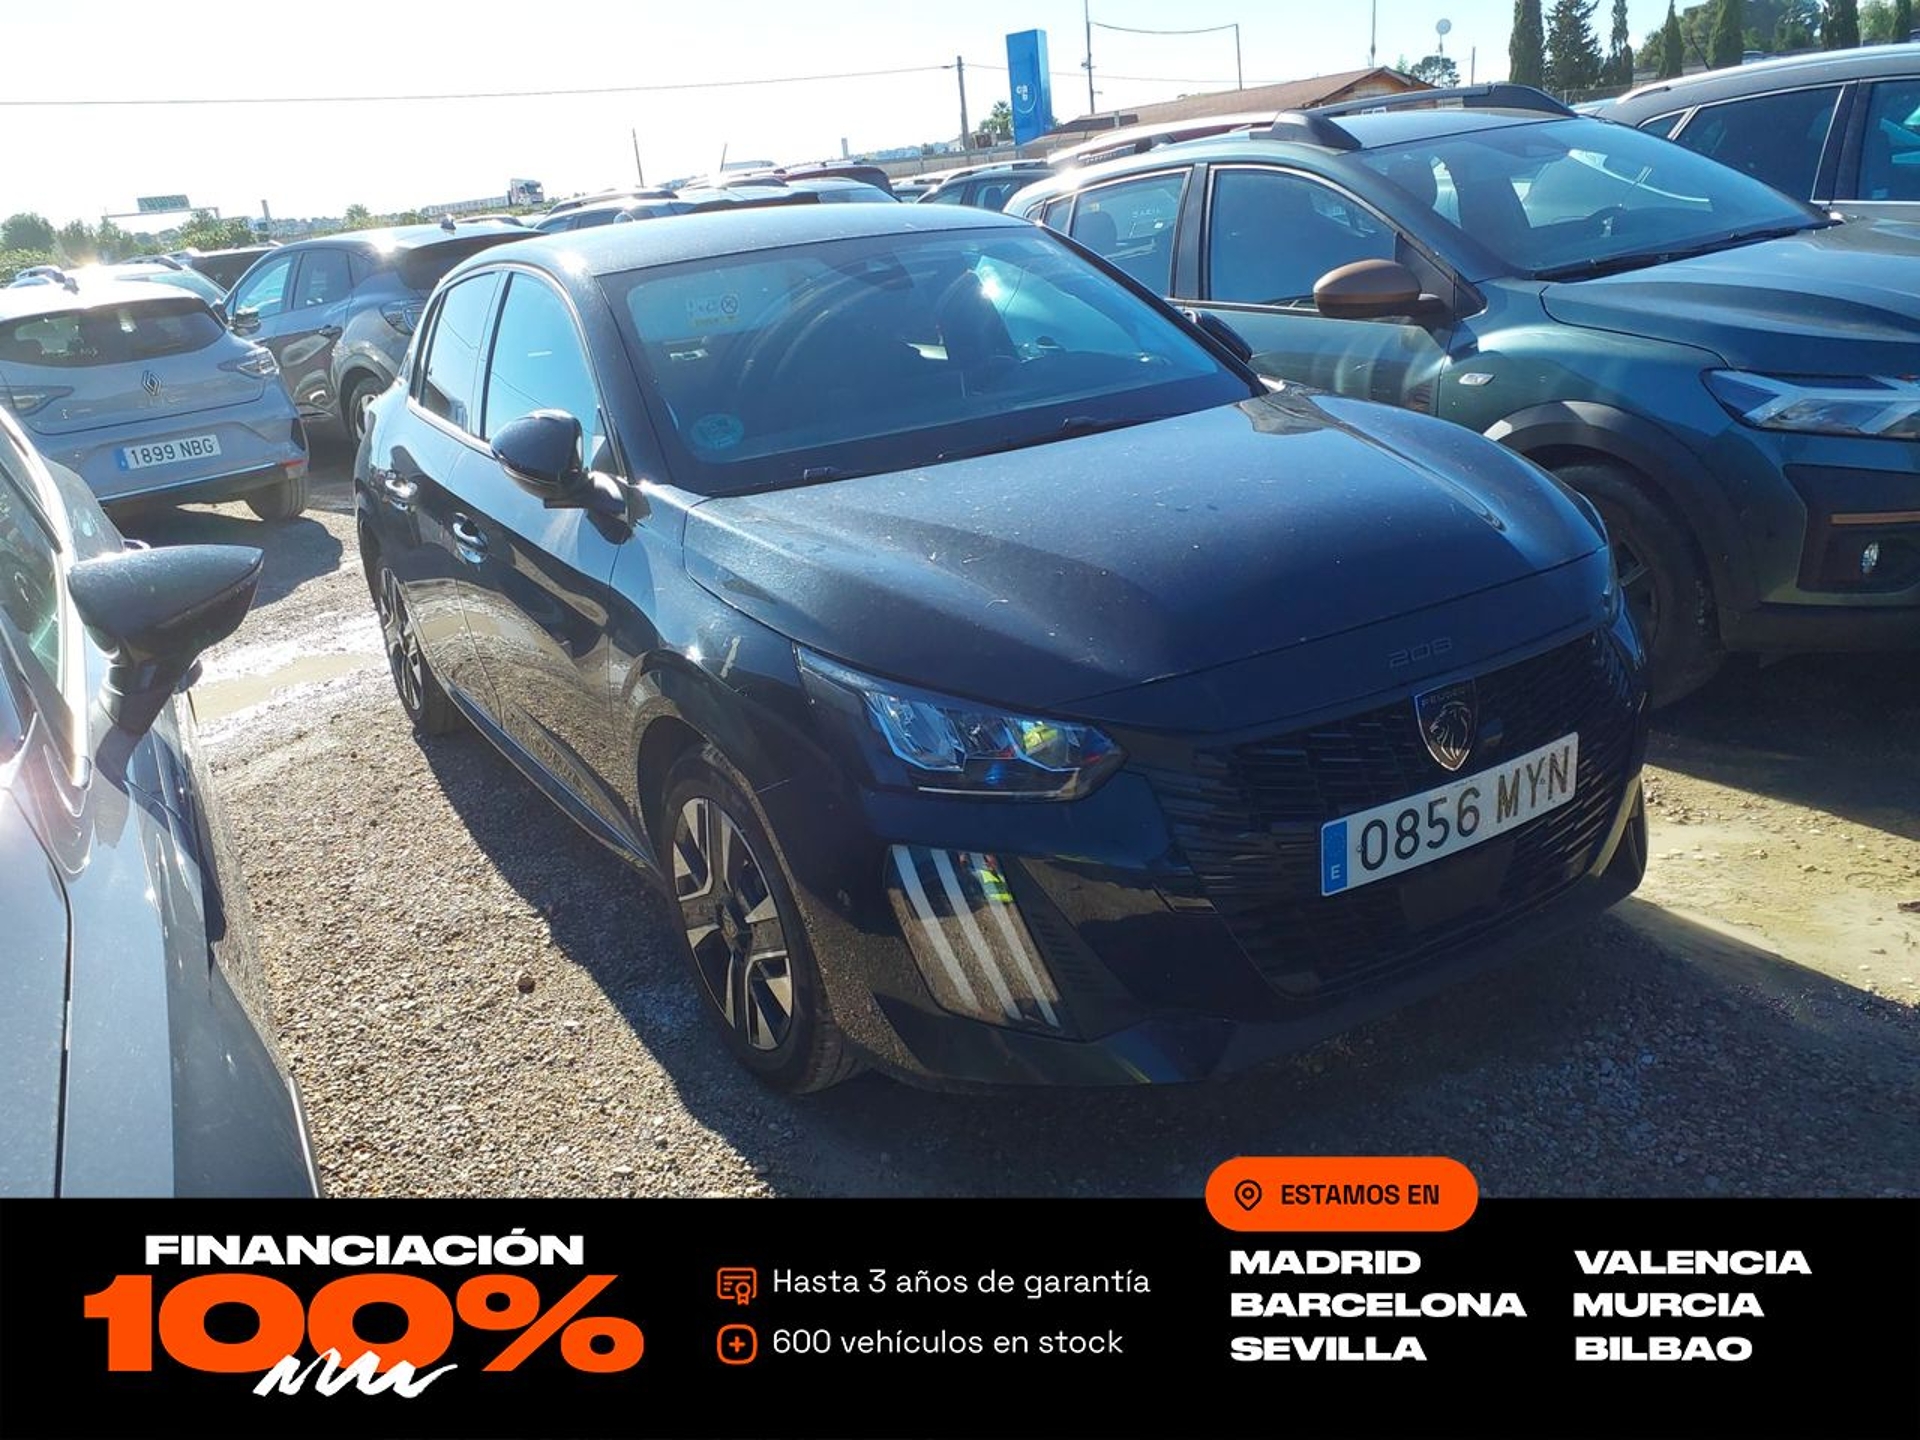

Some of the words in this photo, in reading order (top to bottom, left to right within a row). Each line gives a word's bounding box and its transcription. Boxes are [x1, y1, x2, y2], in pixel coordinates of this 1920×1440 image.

[131, 444, 175, 466] 1899
[179, 438, 214, 458] NBG
[1361, 787, 1481, 870] 0856
[1496, 745, 1570, 824] MYN
[1331, 863, 1341, 880] E
